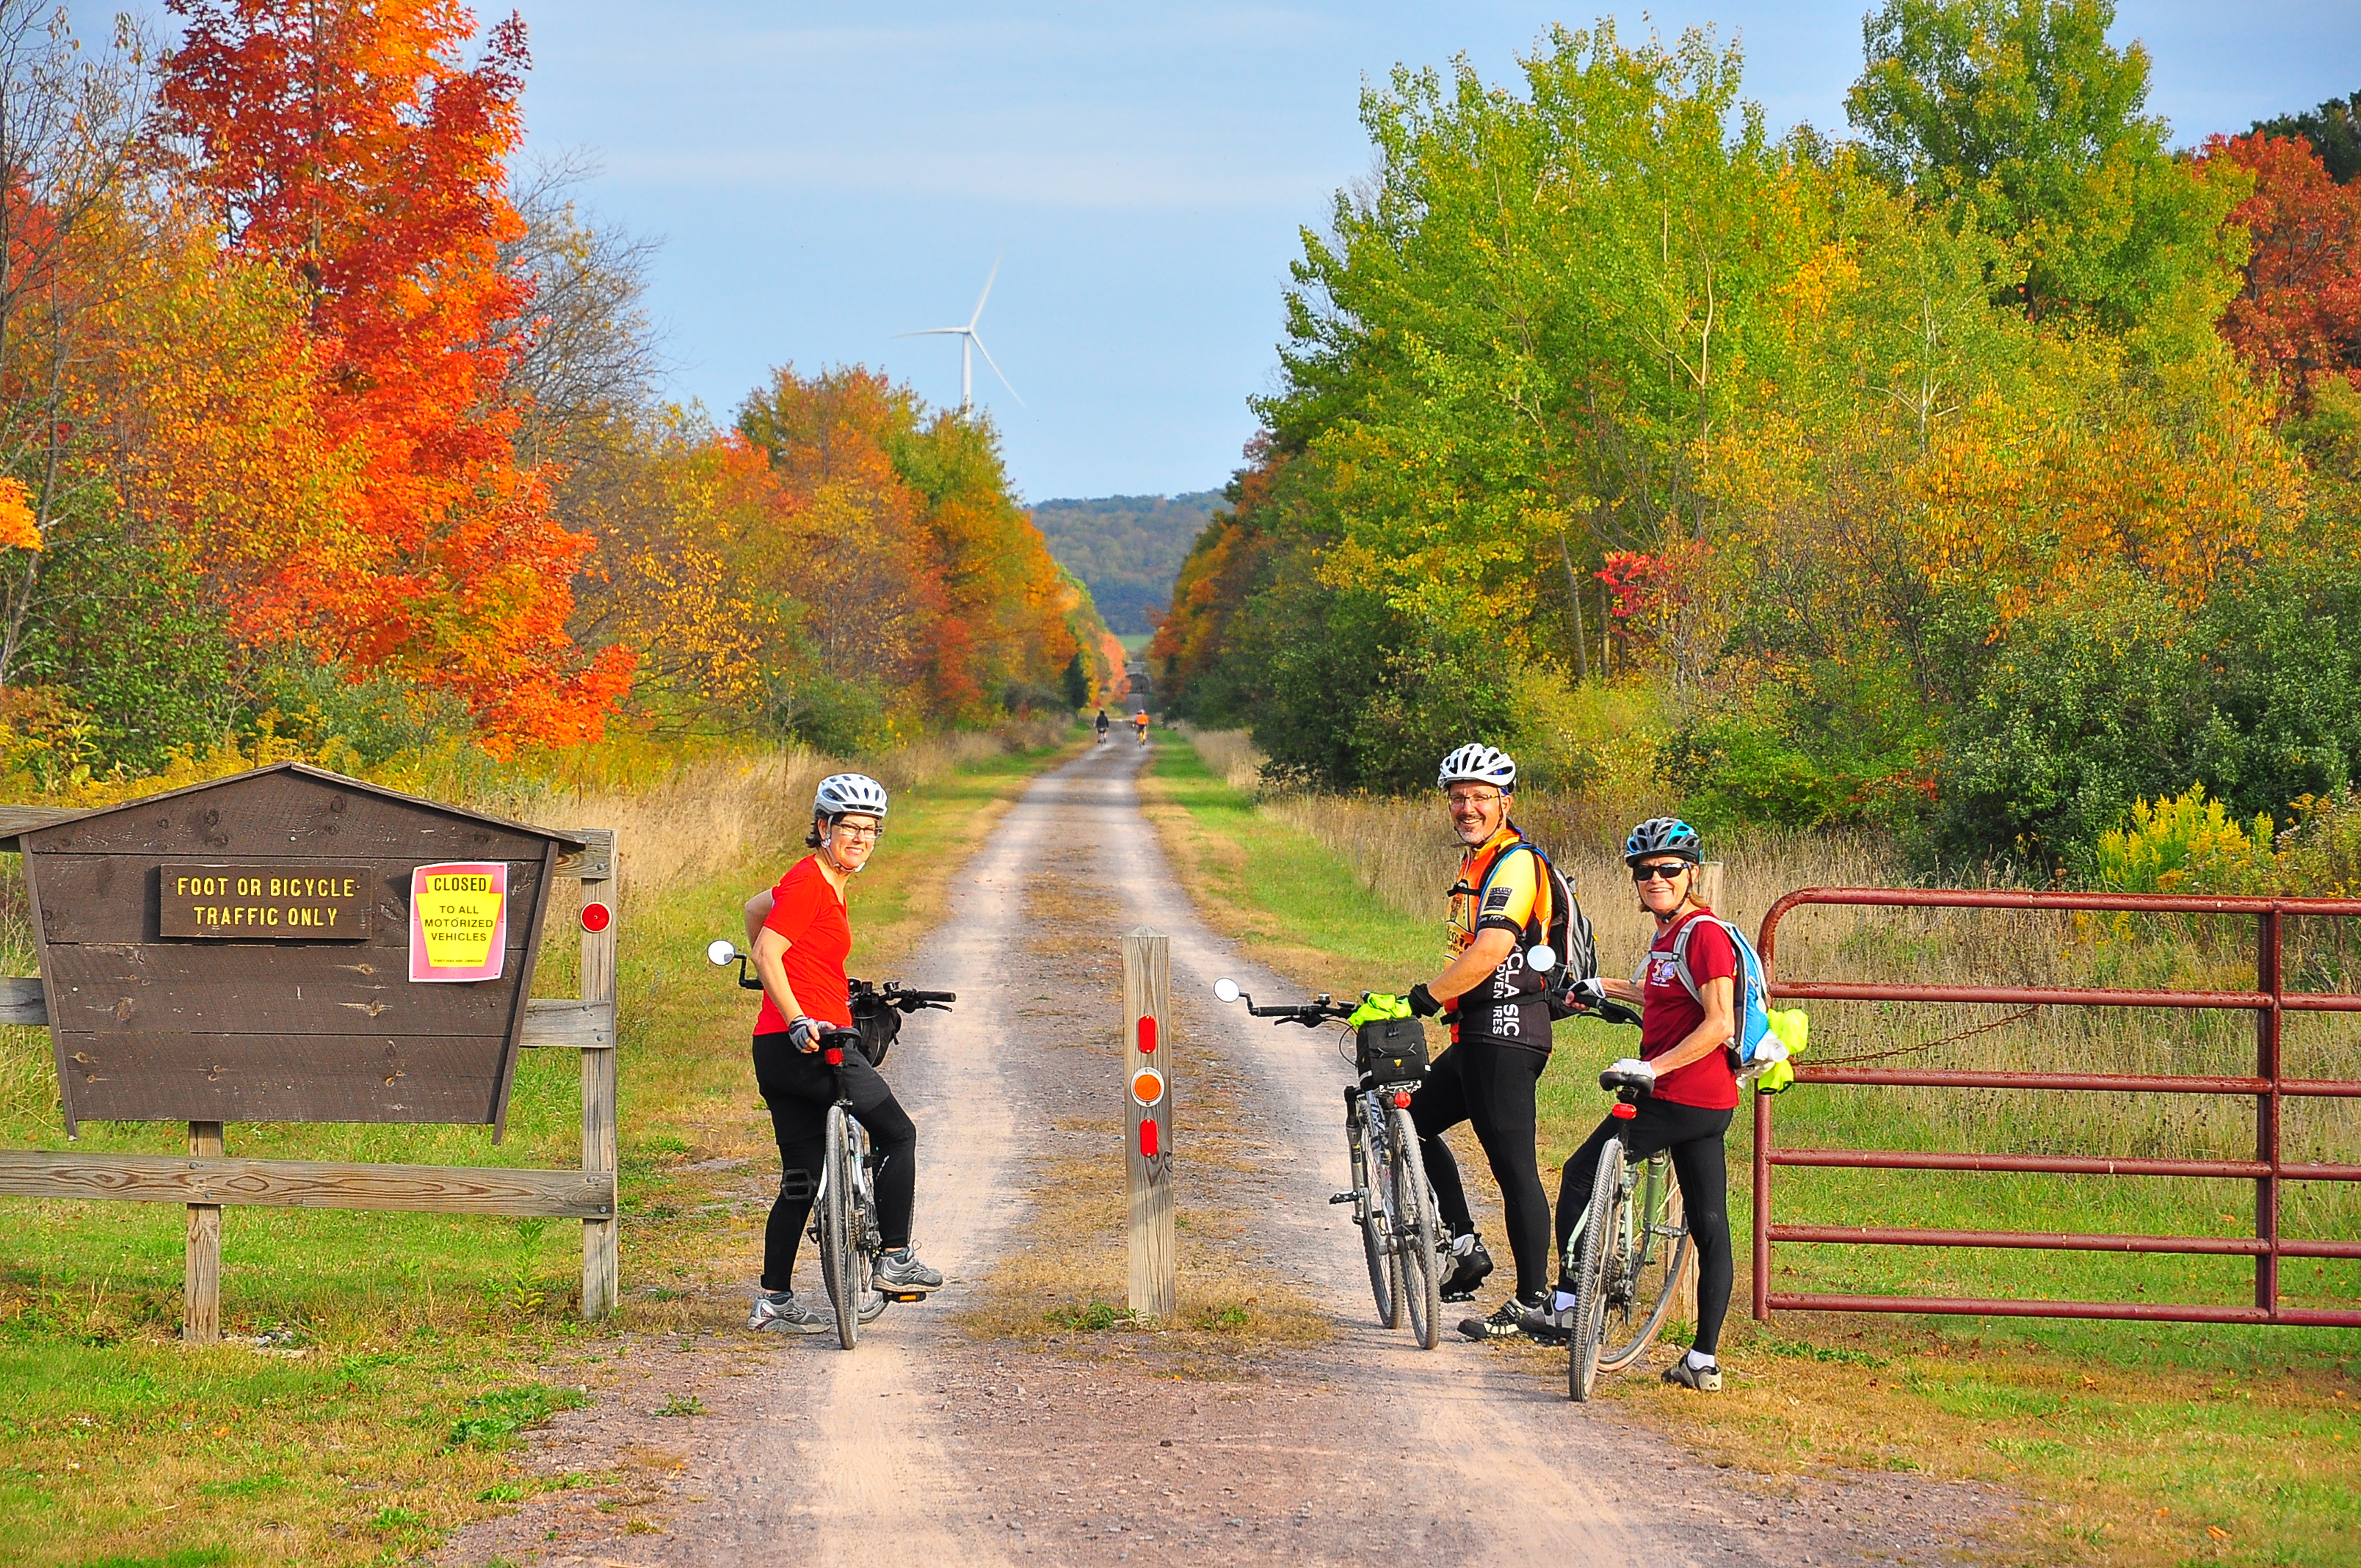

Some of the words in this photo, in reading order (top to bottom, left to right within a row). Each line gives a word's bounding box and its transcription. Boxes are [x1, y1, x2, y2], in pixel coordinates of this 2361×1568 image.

[178, 877, 229, 896] FOOT
[237, 877, 261, 896] OR
[270, 878, 355, 897] BICYCLE
[434, 876, 487, 892] CLOSED
[193, 907, 279, 926] TRAFFIC
[288, 907, 338, 926] ONLY
[439, 905, 455, 914] TO
[458, 905, 479, 915] ALL
[424, 918, 493, 928] MOTORIZED
[431, 932, 487, 942] VEHICLES
[1503, 953, 1524, 1037] CLASIC
